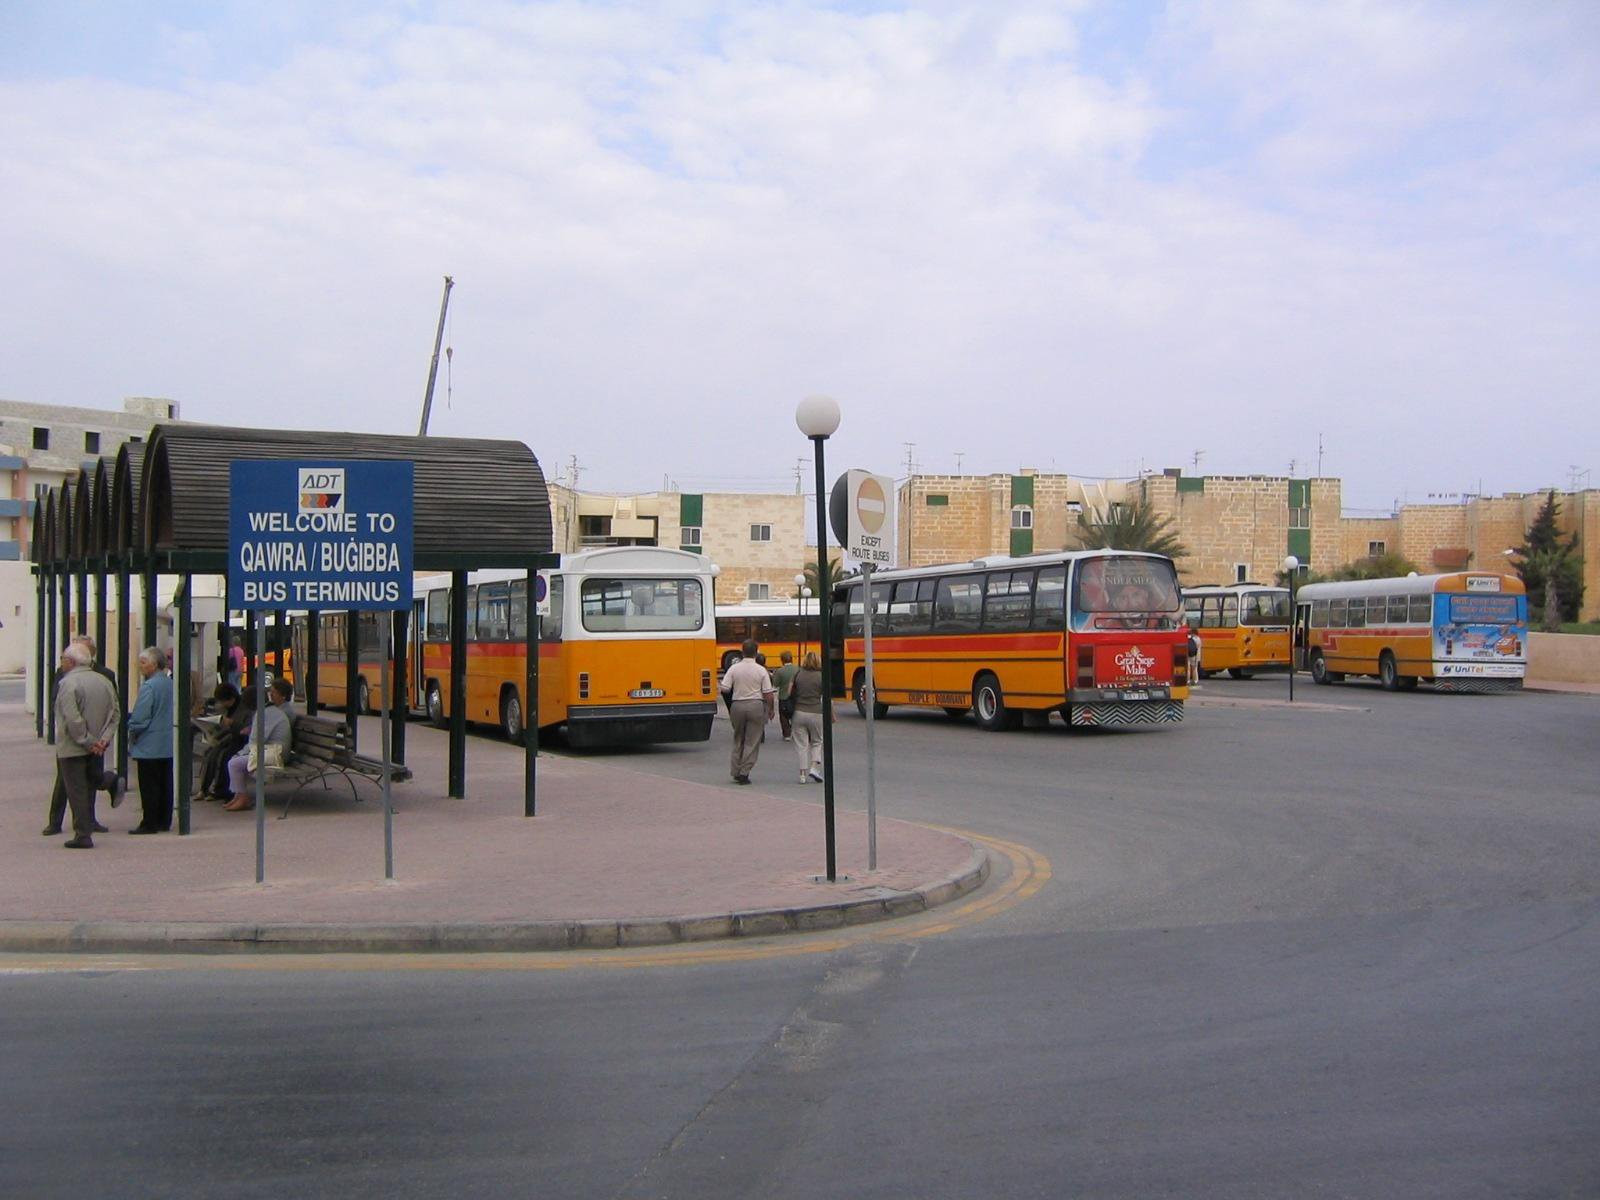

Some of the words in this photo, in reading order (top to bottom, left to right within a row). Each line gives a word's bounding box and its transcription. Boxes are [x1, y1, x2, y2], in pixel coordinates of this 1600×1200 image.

[302, 474, 340, 489] ADT
[249, 512, 357, 532] WELCOME
[366, 513, 396, 532] TO
[861, 535, 881, 547] EXCEPT
[241, 541, 306, 572] QAWRA
[852, 547, 870, 560] ROUTE
[873, 550, 889, 561] BUSES
[244, 582, 287, 601] BUS
[292, 582, 399, 601] TERMINUS
[1115, 654, 1135, 666] Great
[1136, 653, 1155, 667] Siege
[1125, 664, 1146, 675] Malta
[1455, 665, 1484, 673] UniTel
